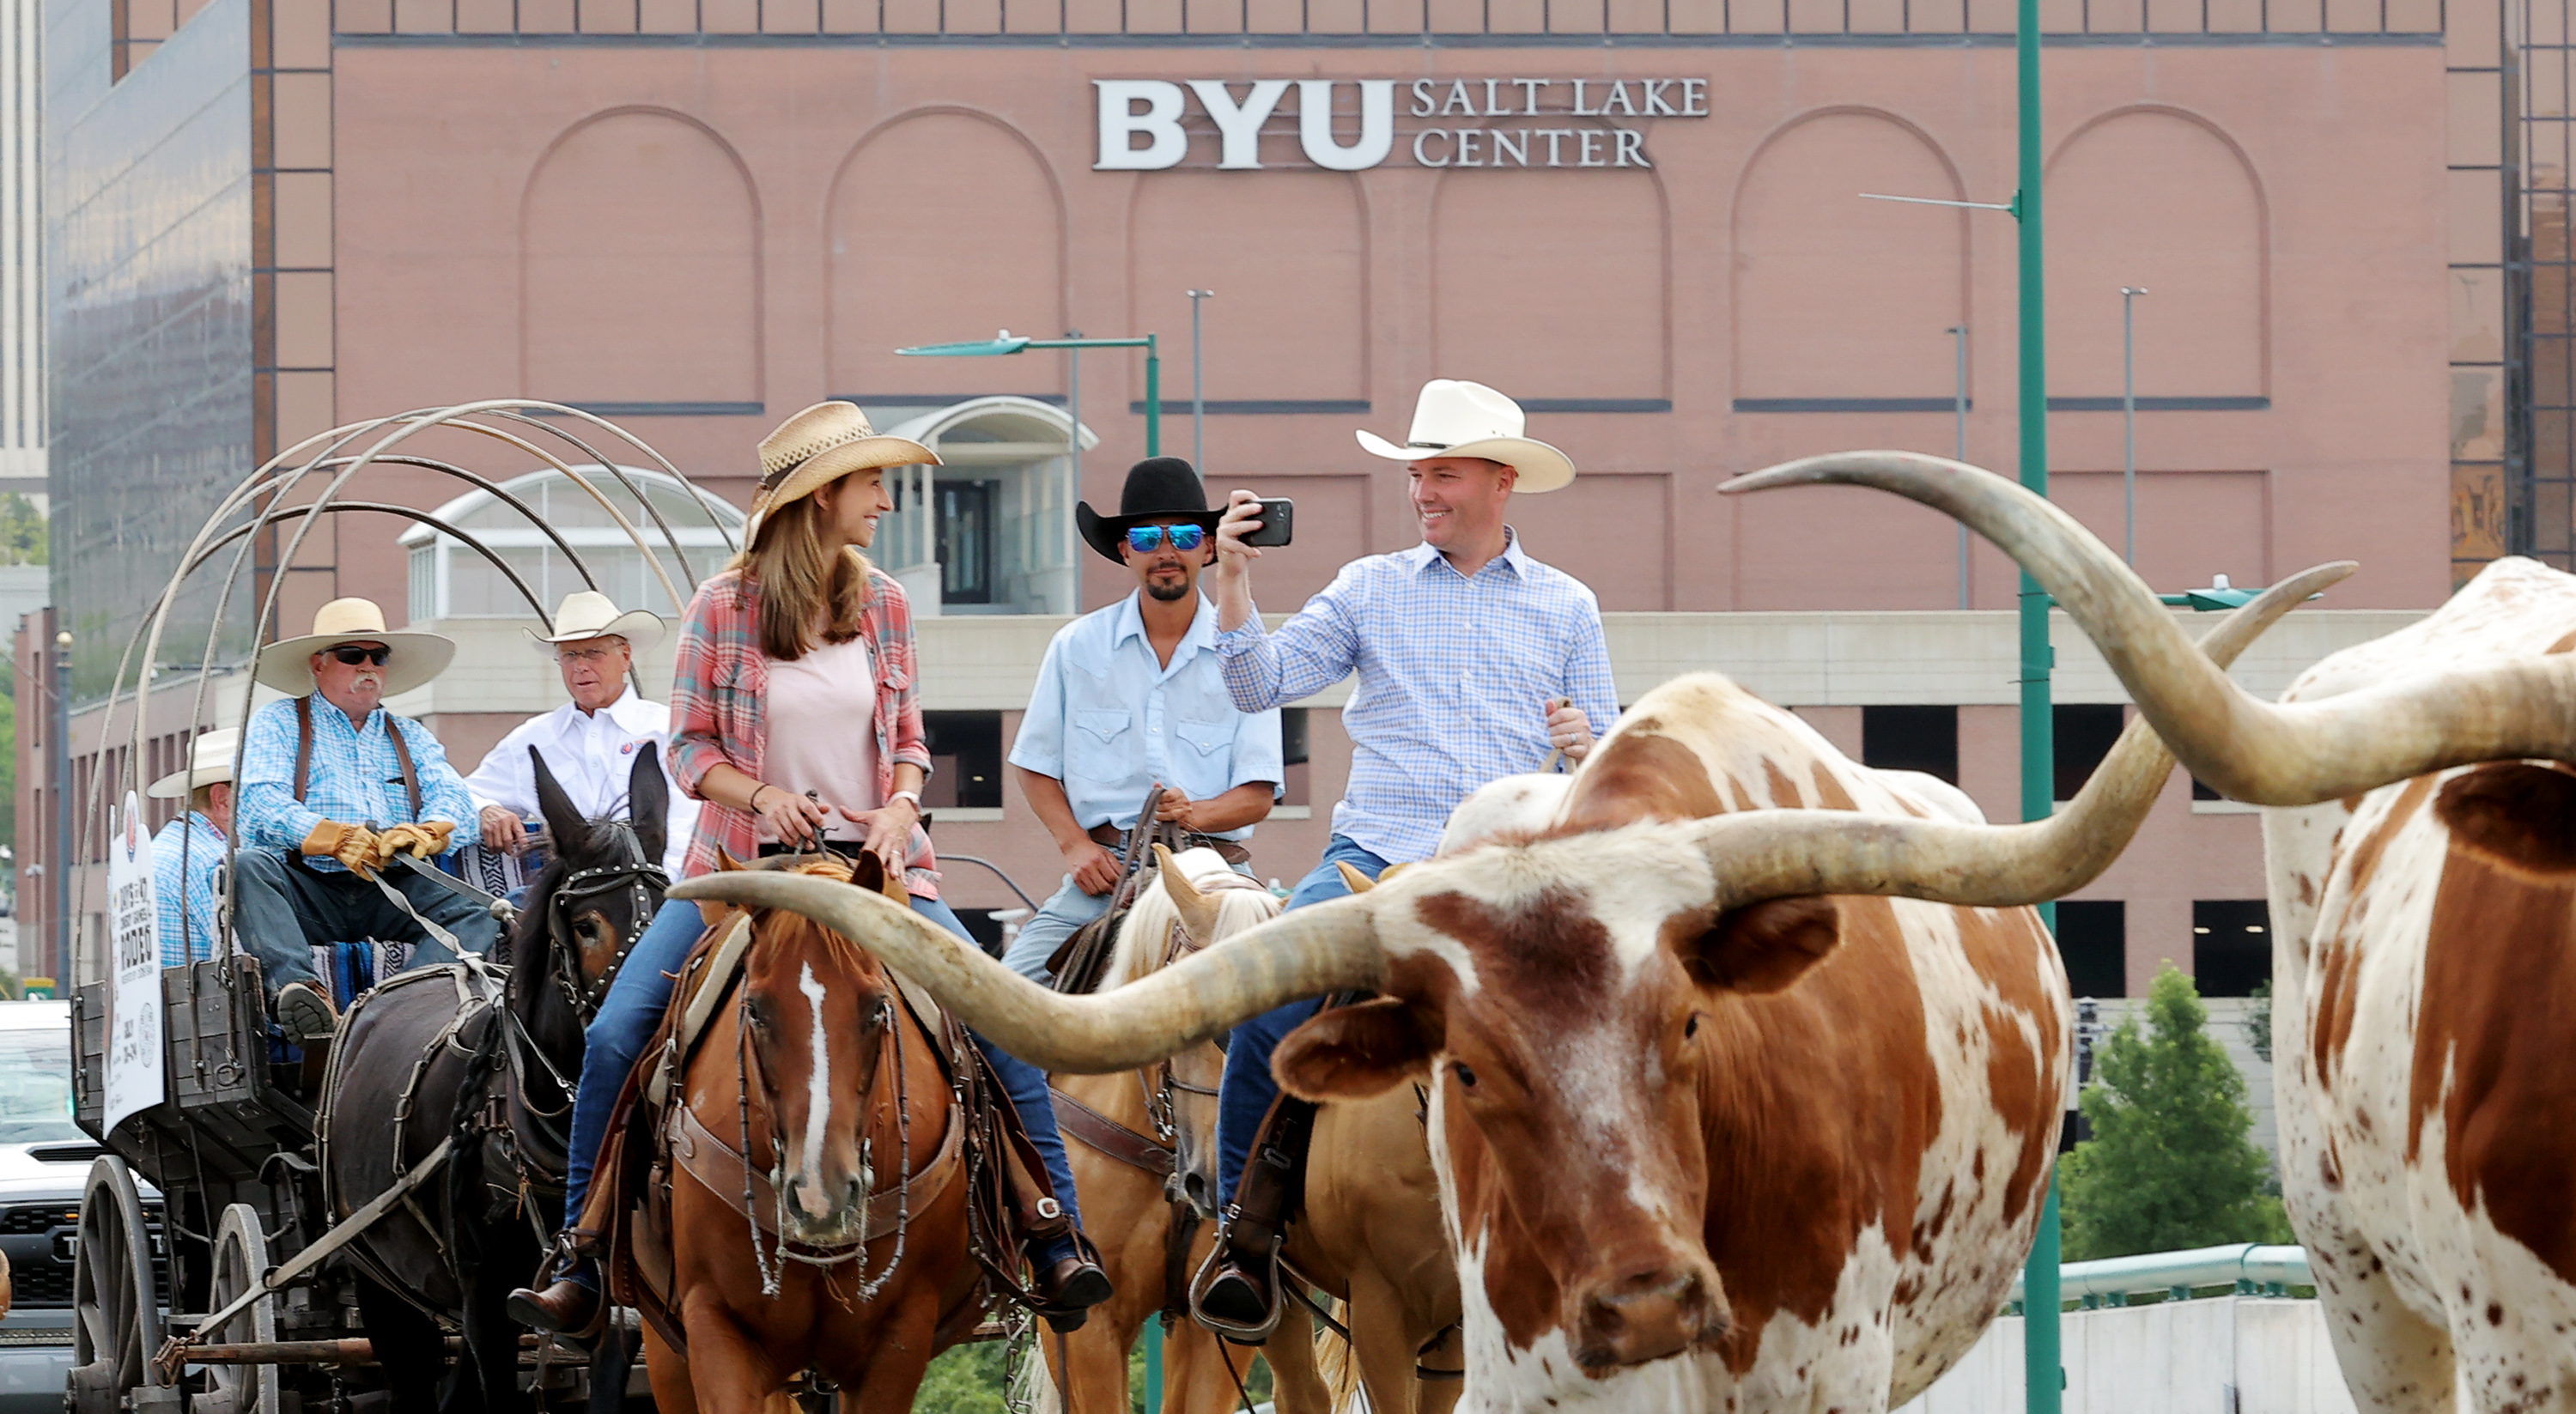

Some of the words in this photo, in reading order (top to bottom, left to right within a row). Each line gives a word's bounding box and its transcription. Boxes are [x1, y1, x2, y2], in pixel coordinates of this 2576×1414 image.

[1412, 77, 1551, 118] SALT
[1571, 77, 1710, 118] LAKE
[1092, 78, 1396, 172] BYU
[1413, 127, 1651, 169] CENTER
